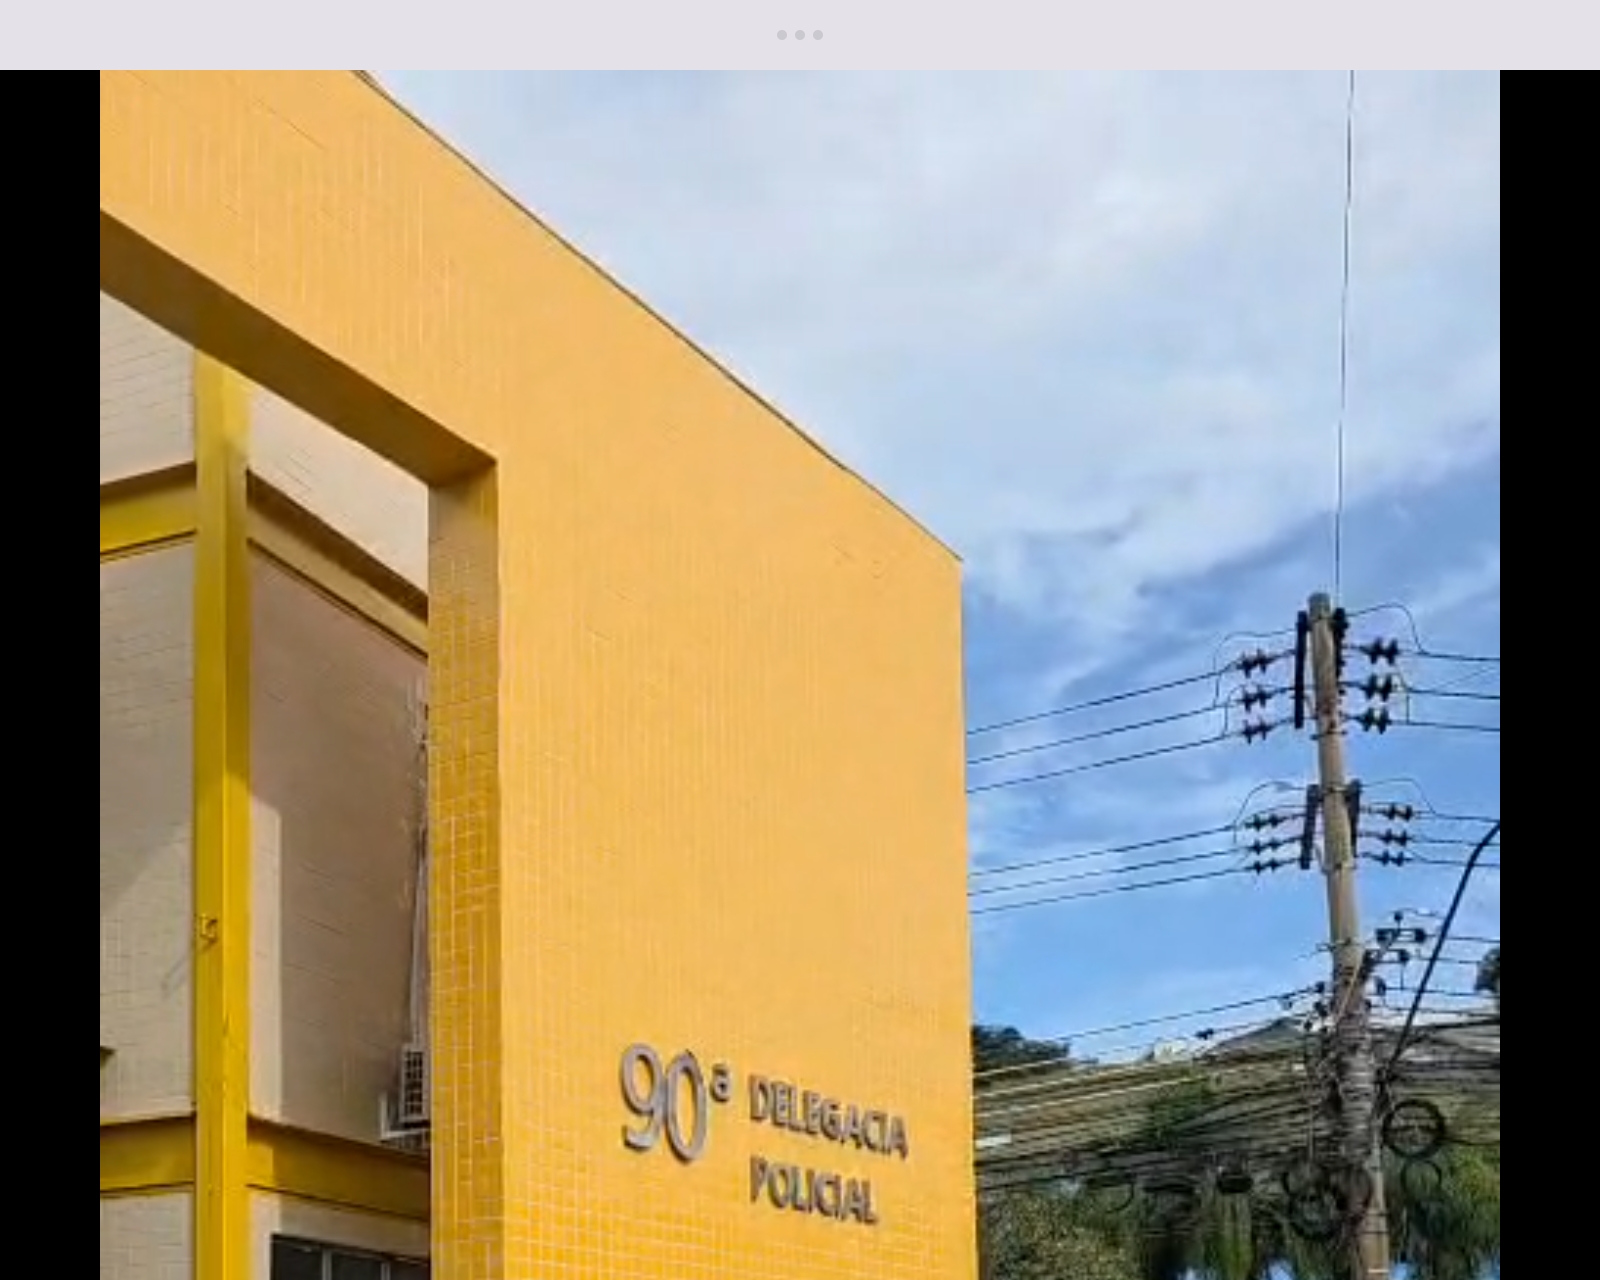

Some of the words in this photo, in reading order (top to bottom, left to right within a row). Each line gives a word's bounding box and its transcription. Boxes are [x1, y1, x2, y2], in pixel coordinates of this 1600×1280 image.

[620, 1043, 732, 1163] 90ª
[749, 1073, 909, 1159] DELEGACIA
[750, 1155, 878, 1225] POLICIAL
